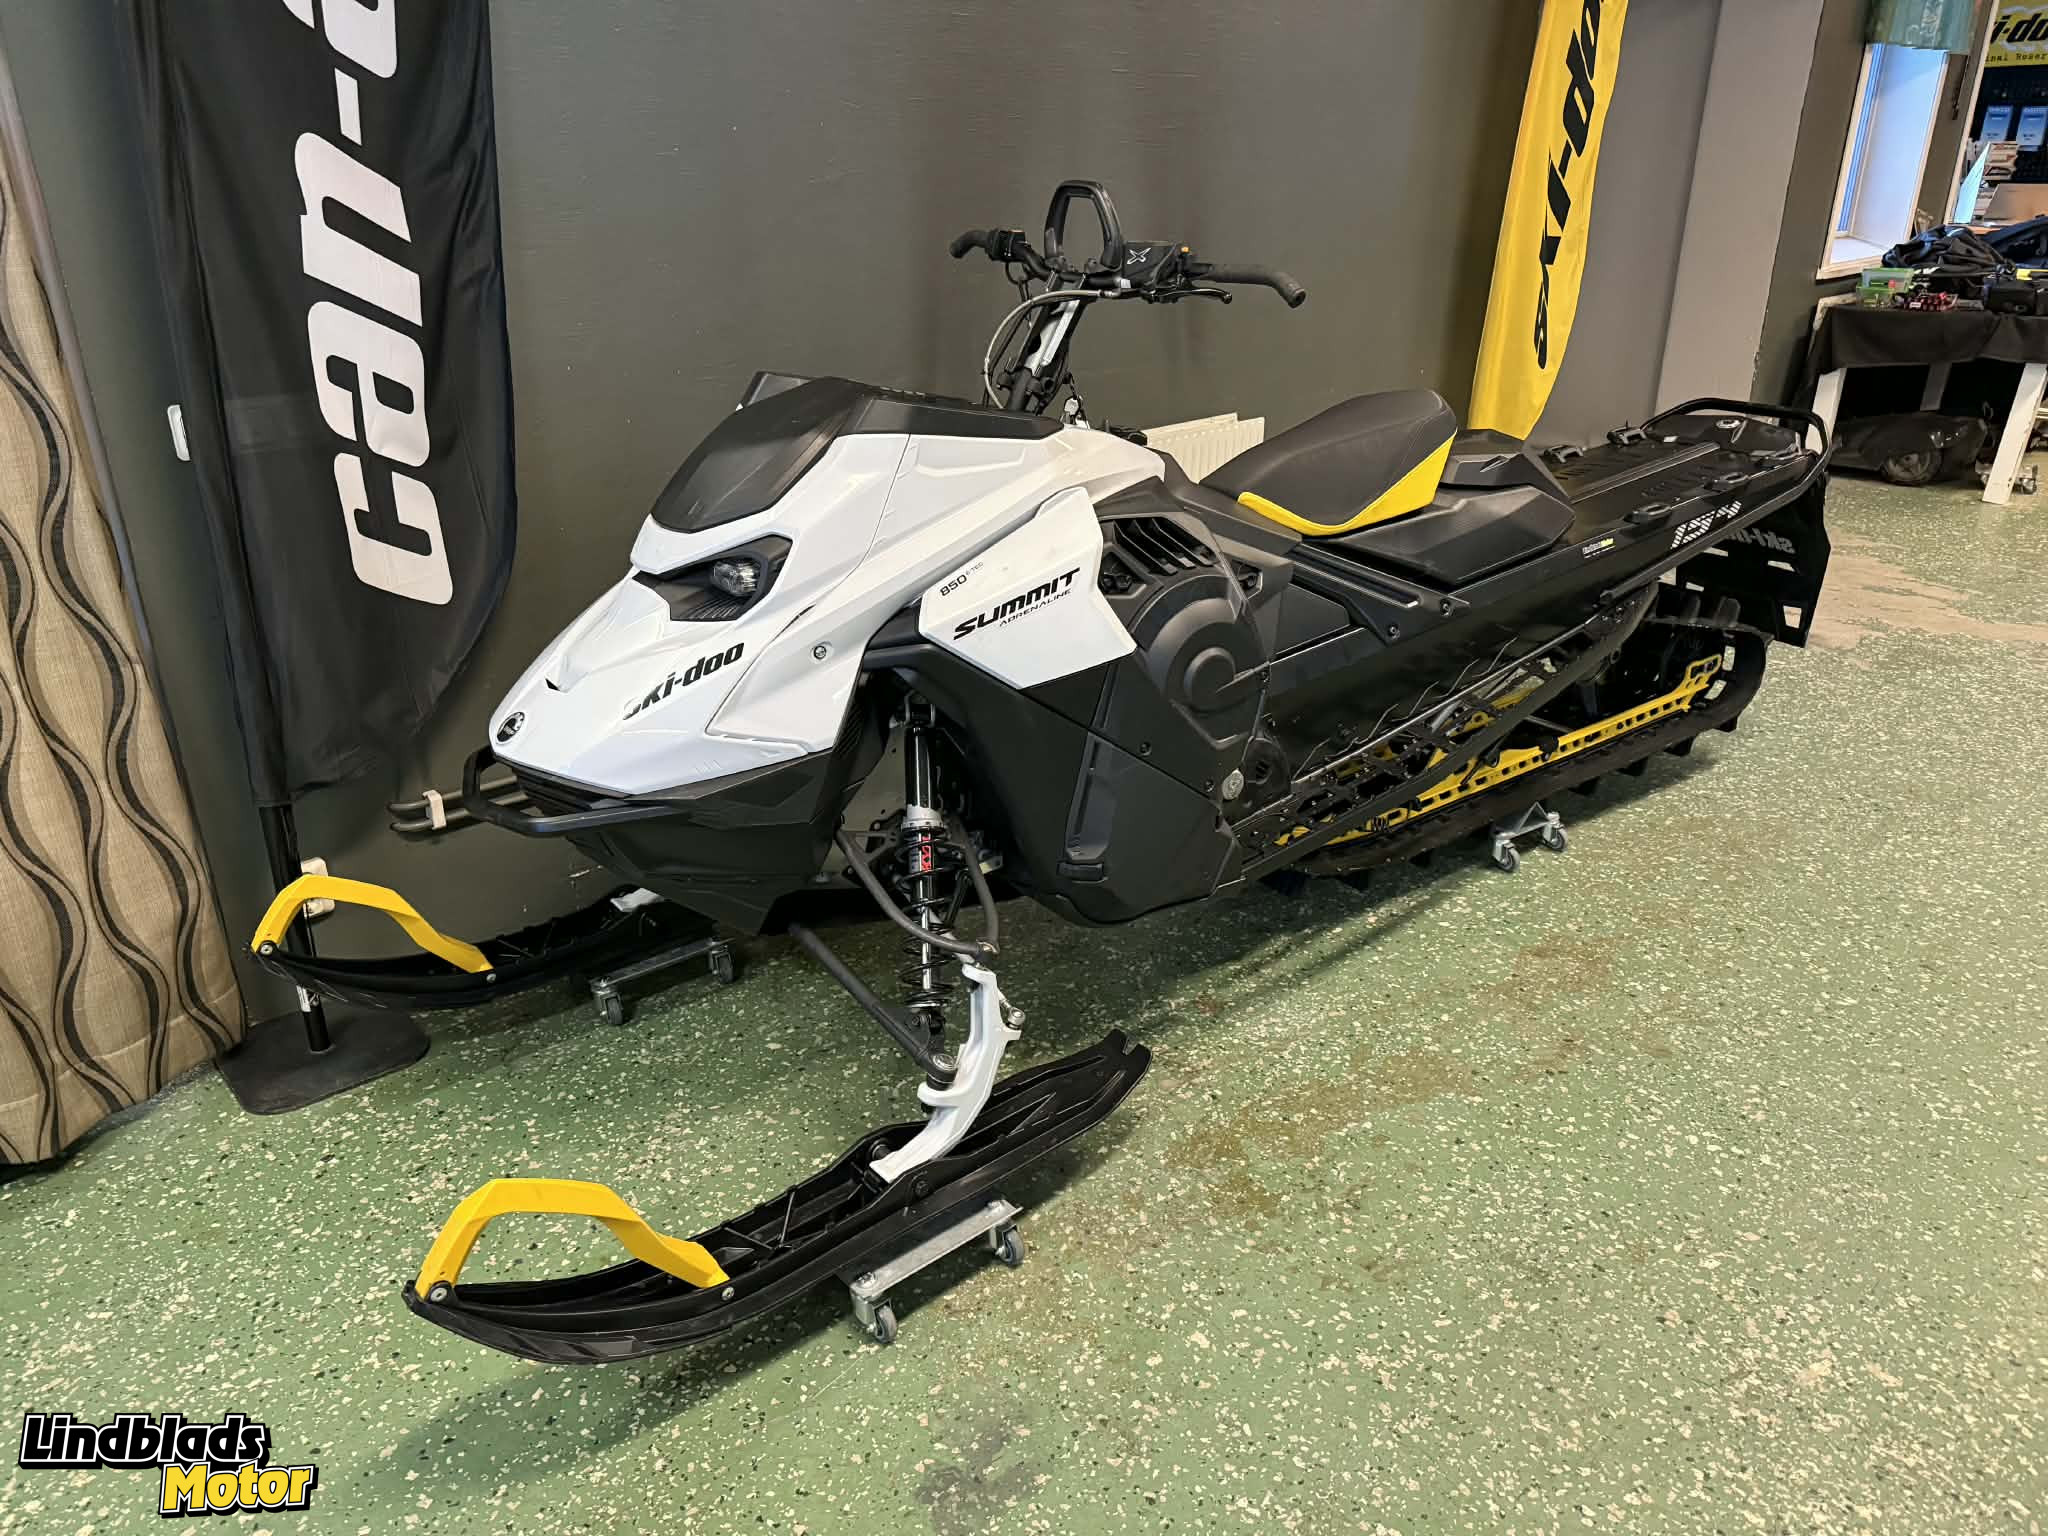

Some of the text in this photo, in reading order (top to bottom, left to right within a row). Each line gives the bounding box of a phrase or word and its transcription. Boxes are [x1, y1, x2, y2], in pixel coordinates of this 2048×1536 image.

[1534, 0, 1605, 370] ski-do
[940, 574, 967, 597] 850
[953, 567, 1080, 640] SUMMIT
[1000, 588, 1072, 628] ADRENALINE
